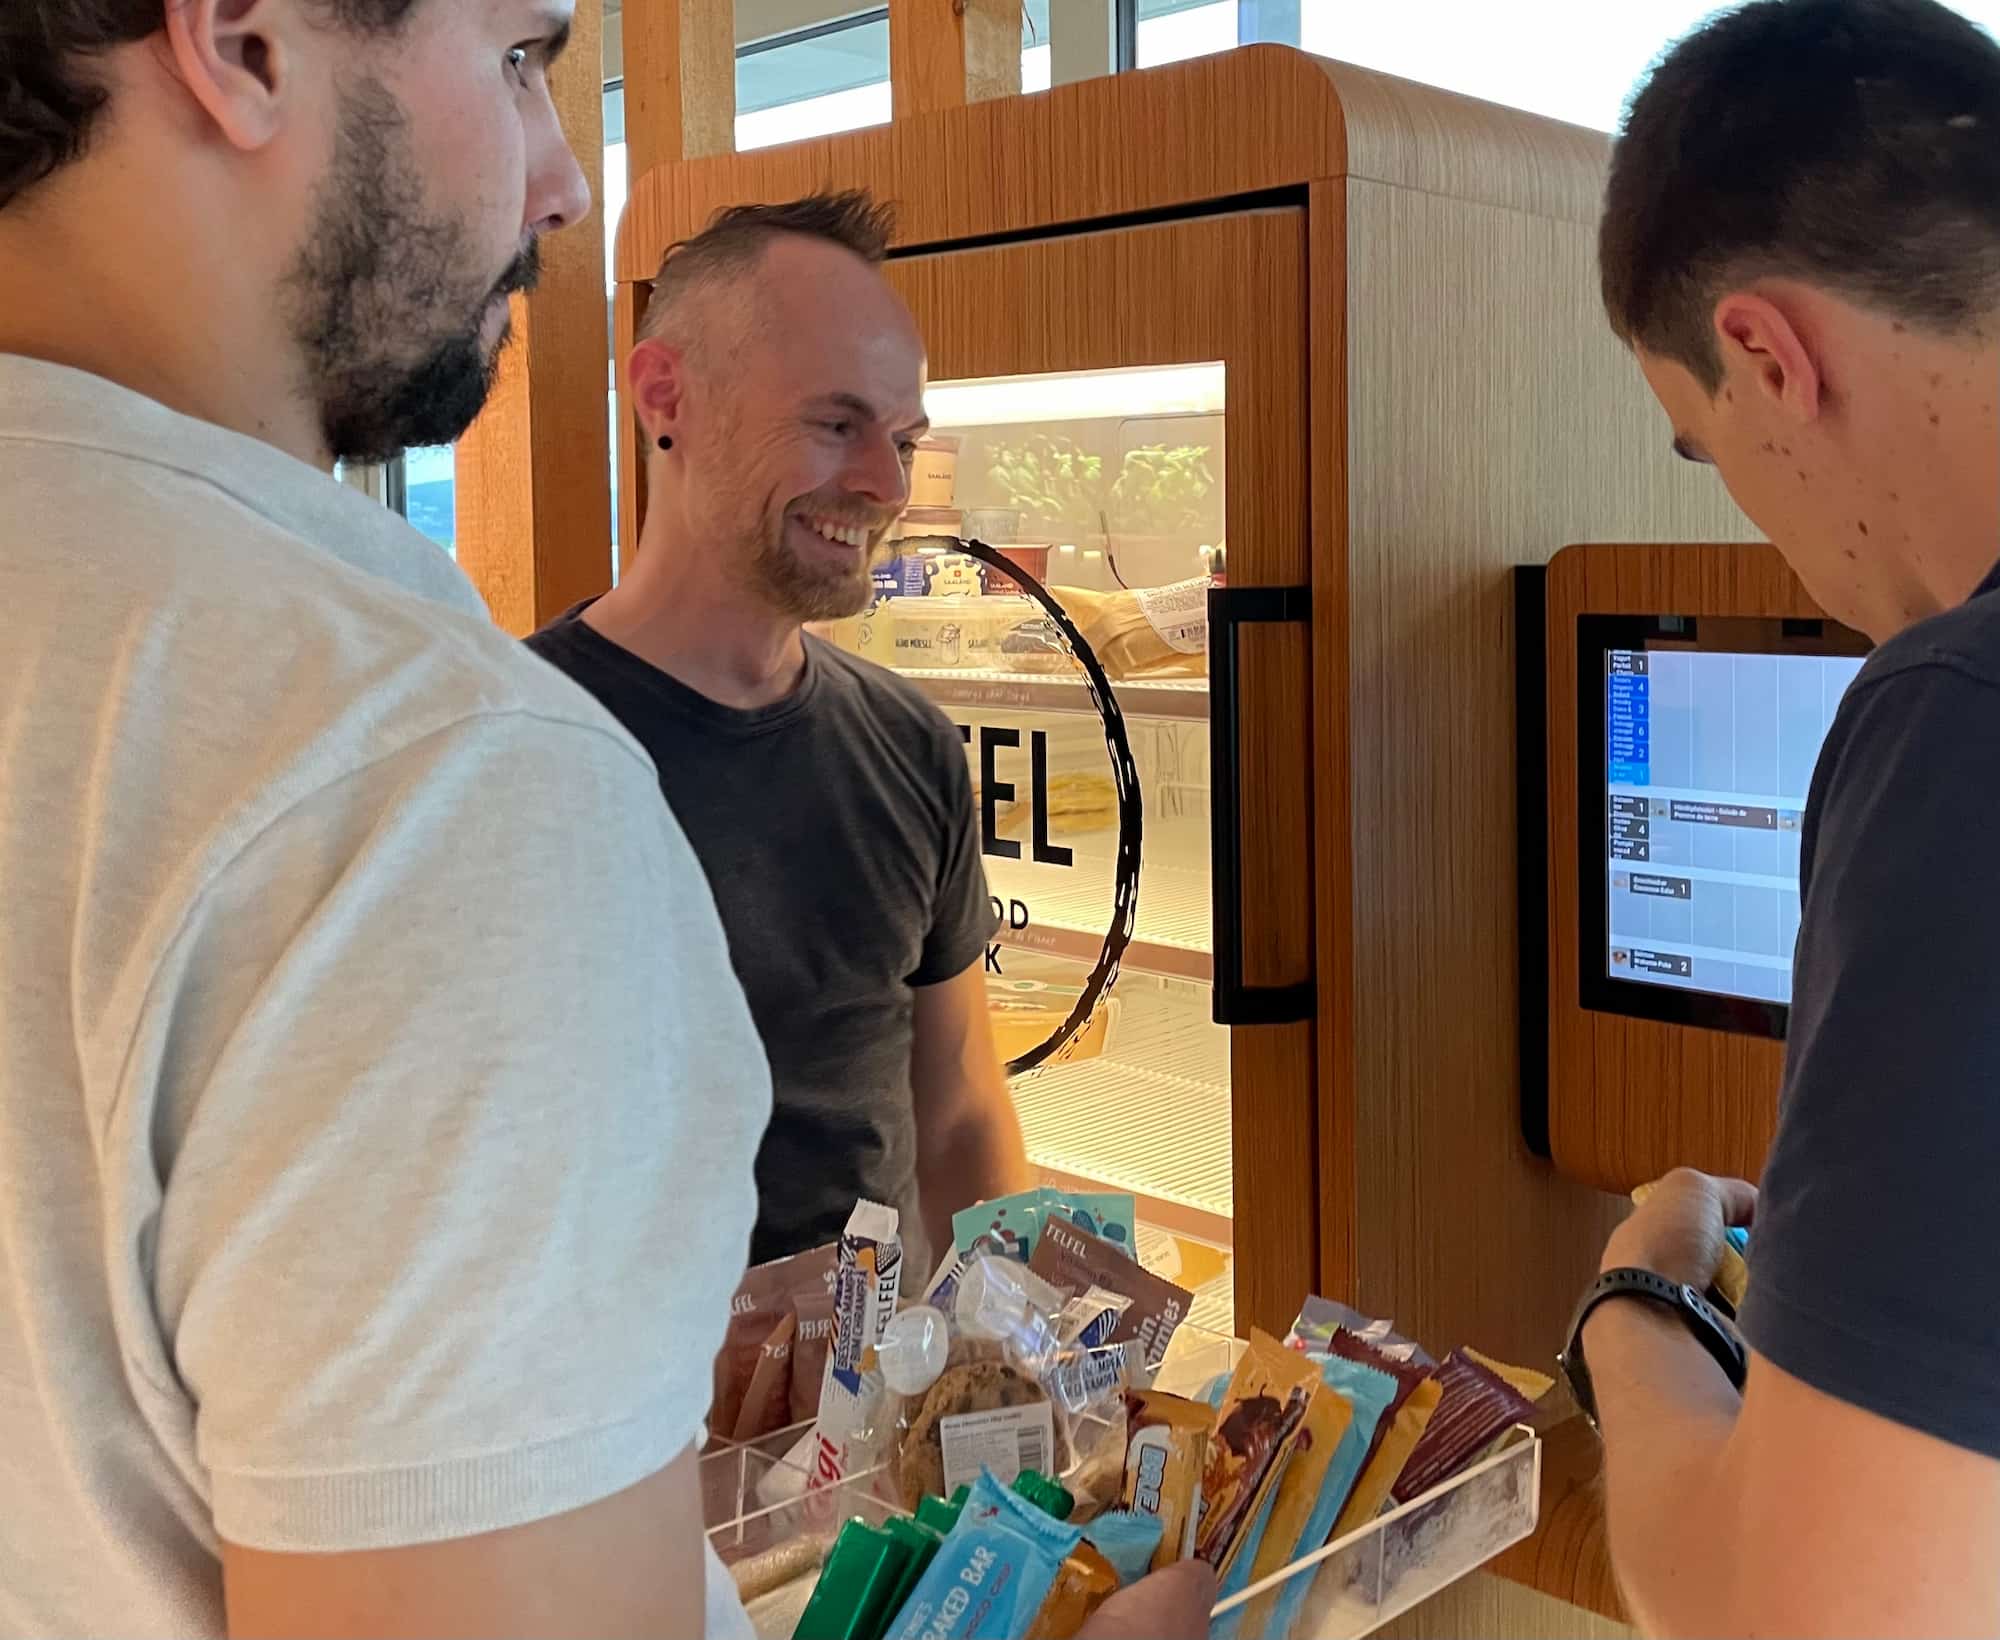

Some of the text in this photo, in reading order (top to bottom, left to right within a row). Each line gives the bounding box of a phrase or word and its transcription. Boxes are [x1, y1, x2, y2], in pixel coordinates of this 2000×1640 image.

[956, 723, 1073, 867] EL
[1046, 1223, 1089, 1258] FELFEL
[957, 1544, 998, 1588] BAR
